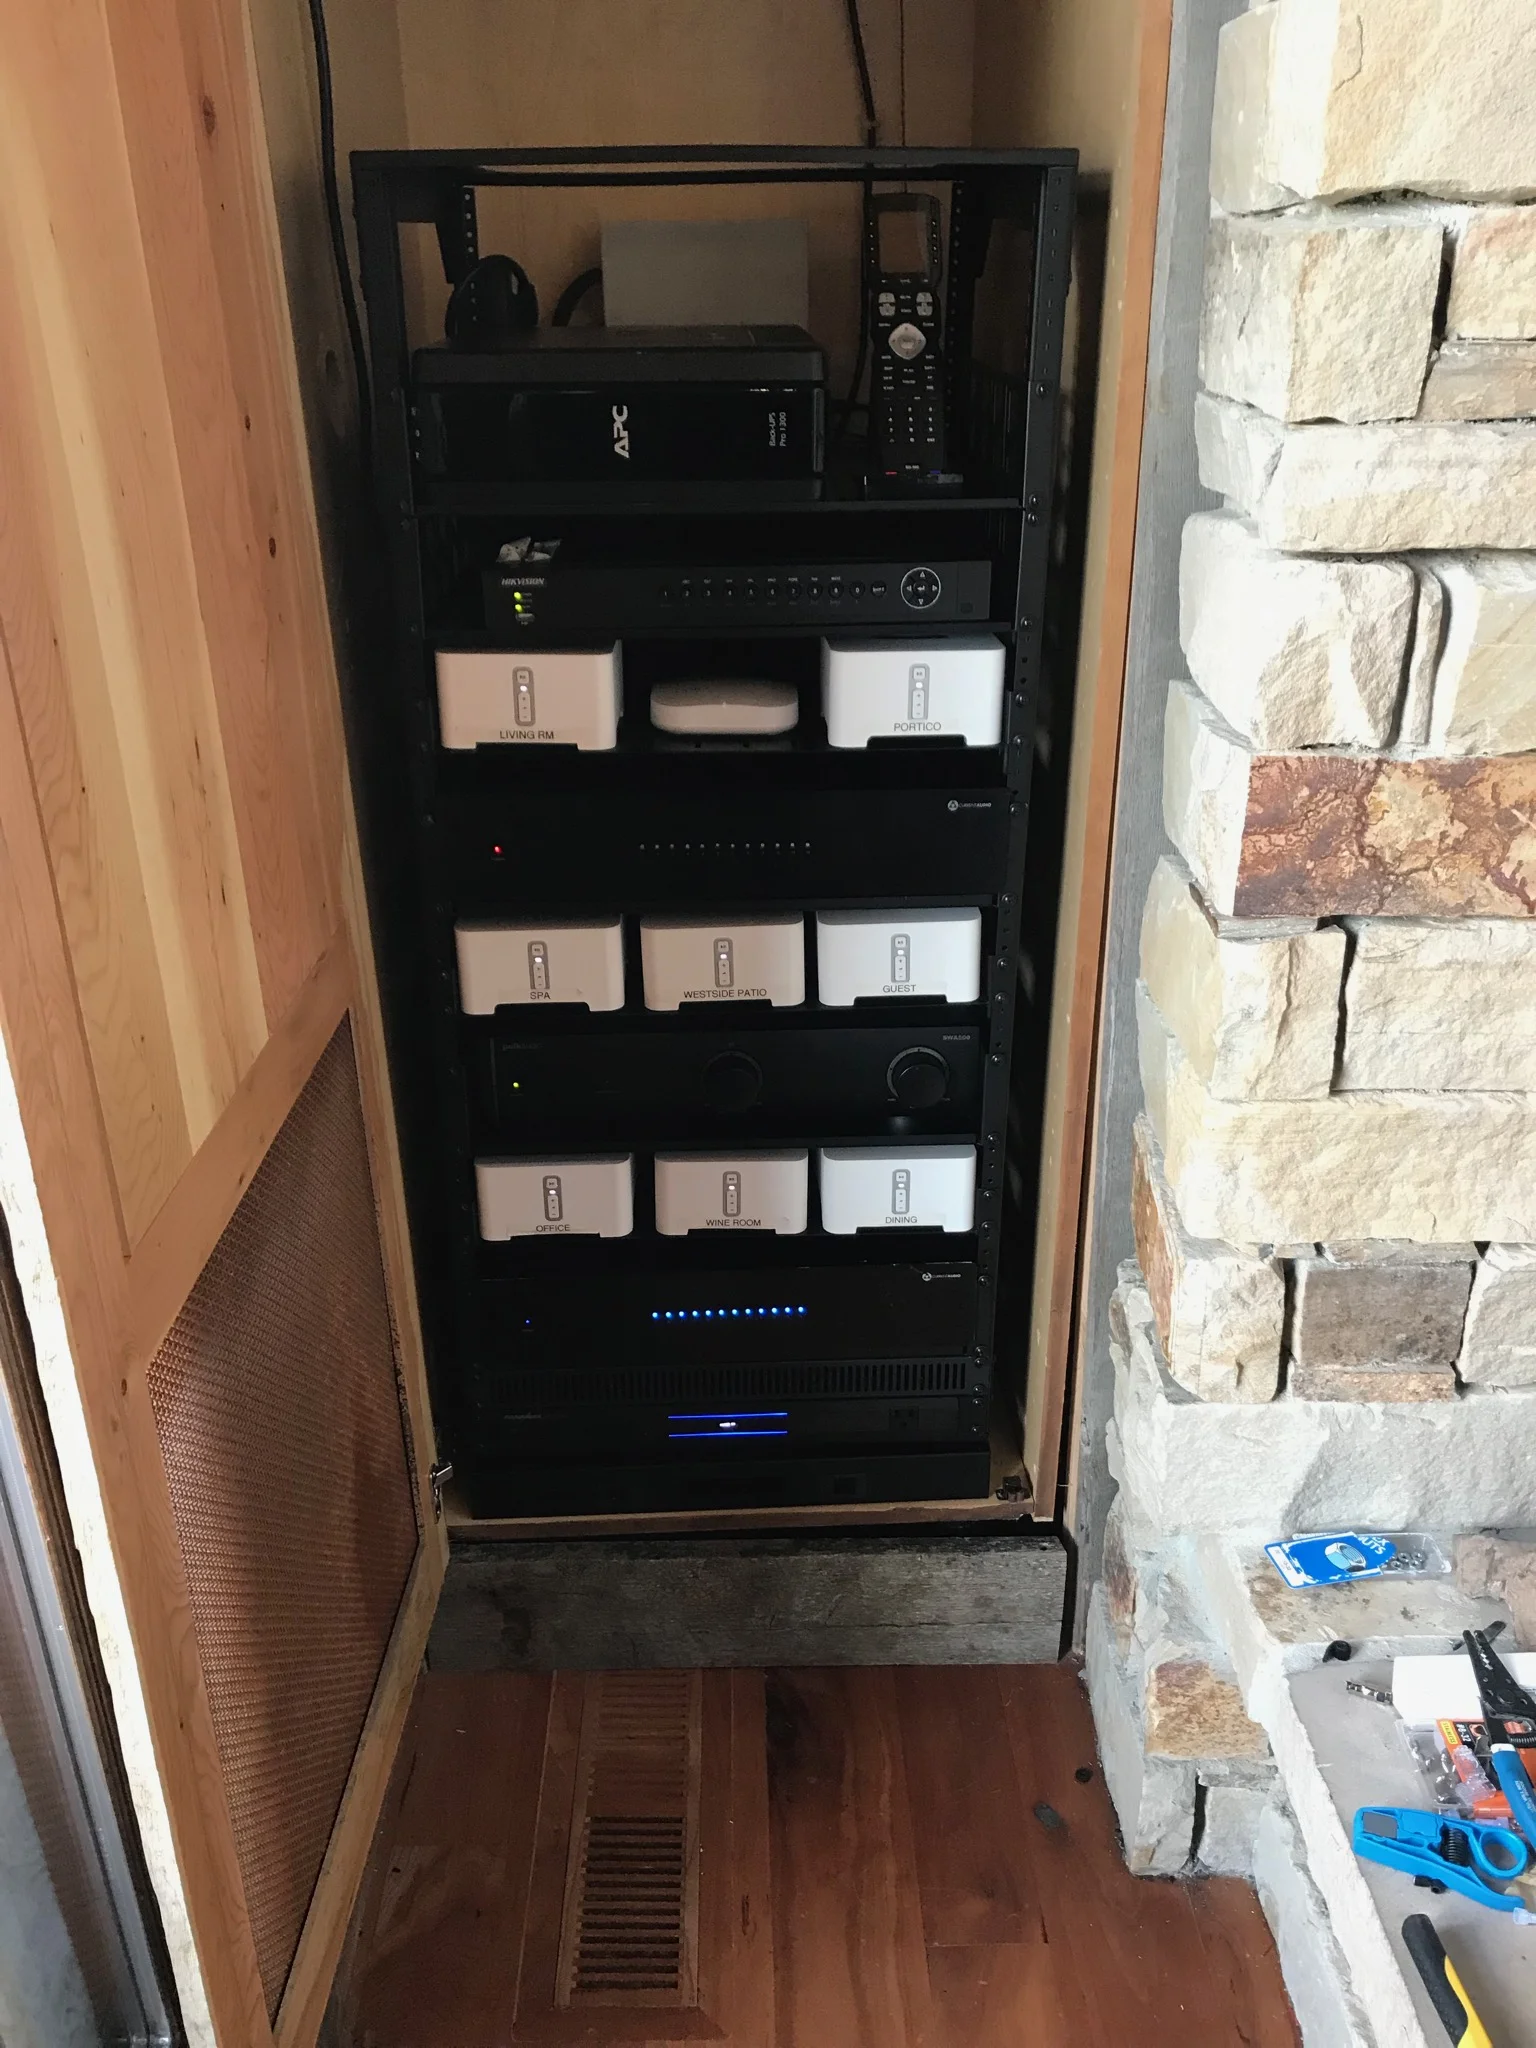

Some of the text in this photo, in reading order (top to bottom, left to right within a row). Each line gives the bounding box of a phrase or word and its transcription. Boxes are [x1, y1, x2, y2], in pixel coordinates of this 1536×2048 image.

[612, 405, 630, 459] APC
[779, 411, 787, 447] Pro 1300
[501, 577, 545, 586] HIKVISION
[893, 722, 942, 732] PORTICO
[499, 730, 555, 740] LIVING RM
[882, 984, 917, 993] GUEST
[529, 991, 551, 1000] SPA
[683, 988, 767, 999] WESTSIDE PATIO
[705, 1219, 762, 1227] WINE ROOM
[885, 1216, 918, 1224] DINING
[535, 1224, 571, 1233] OFFICE
